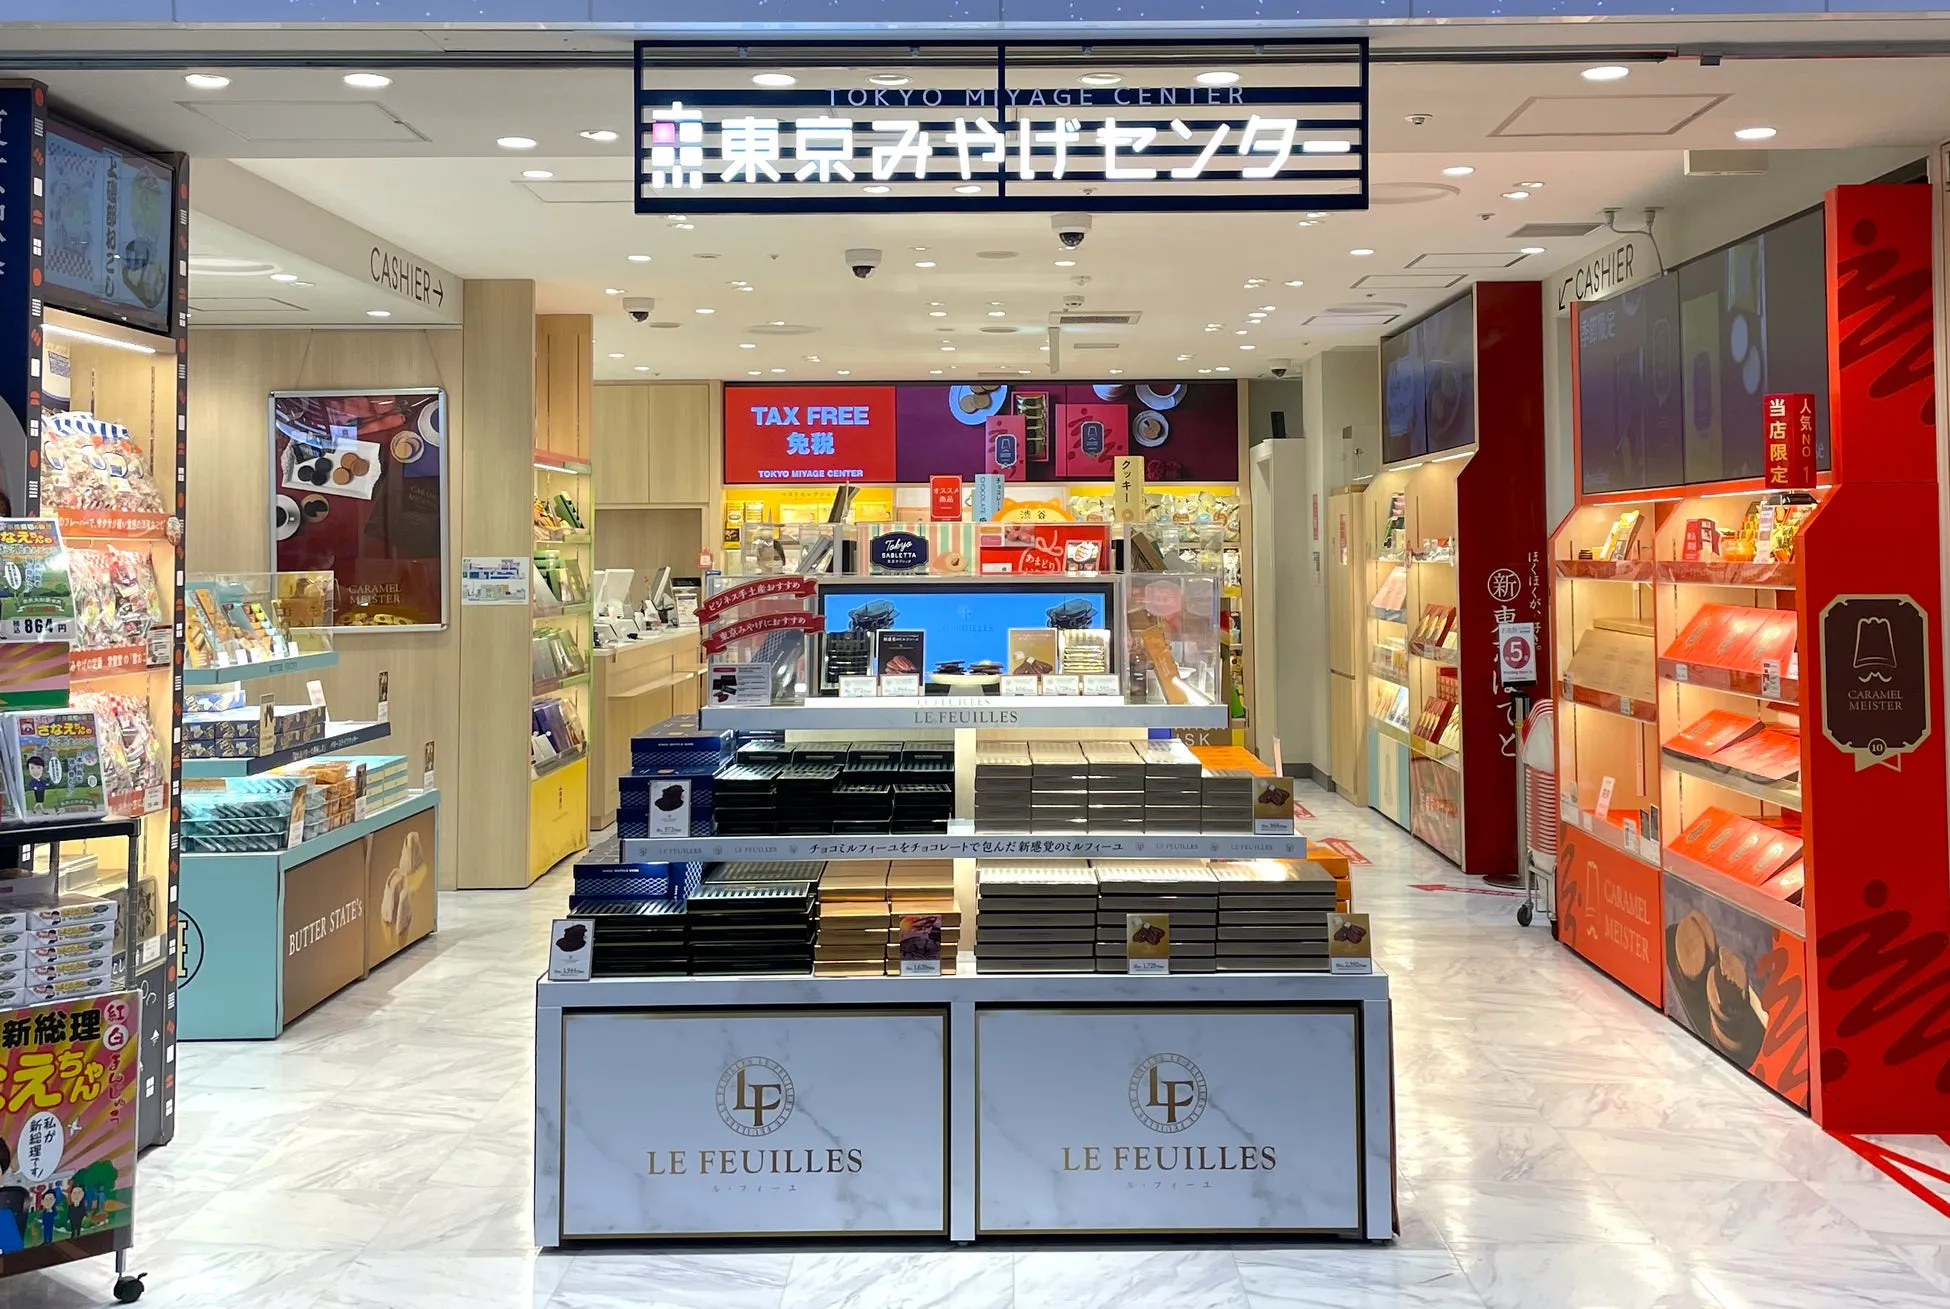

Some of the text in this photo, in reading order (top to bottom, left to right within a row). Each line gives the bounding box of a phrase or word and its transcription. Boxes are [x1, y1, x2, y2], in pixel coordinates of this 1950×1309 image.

[826, 85, 1245, 107] TOKYO MIYAGE CENTER
[720, 114, 1351, 181] 東京みやげセンター
[370, 246, 430, 305] CASHIER
[1575, 244, 1635, 300] CASHIER
[751, 406, 870, 426] TAX FREE
[786, 432, 836, 455] 免税
[1769, 398, 1789, 484] 当店限定
[758, 469, 864, 478] TOKYO MIYAGE CENTER
[1121, 460, 1132, 503] クッキー
[933, 487, 961, 495] オススメ
[1020, 510, 1046, 519] 渋谷
[885, 538, 913, 552] Tokyo
[348, 583, 402, 594] CARAMEL
[349, 593, 401, 605] MEISTER
[708, 580, 801, 612] ビジネス手土産おすすめ
[24, 618, 54, 634] 864
[57, 623, 67, 633] 円
[719, 616, 806, 641] 東京みやげにおすすめ
[1510, 641, 1523, 662] 5
[1847, 690, 1904, 700] CARAMEL
[1848, 701, 1904, 711] MEISTER
[914, 710, 1018, 724] LE FEUILLES
[1871, 743, 1884, 752] 10
[1604, 879, 1651, 925] CARAMEL
[289, 897, 364, 957] BUTTER STATE's
[1605, 914, 1650, 964] MEISTER
[2, 1008, 102, 1050] 新総理
[0, 1050, 104, 1113] えちゃん
[43, 1116, 57, 1145] 私が
[646, 1148, 863, 1175] LE FEUILLES
[1061, 1145, 1277, 1171] LE FEUILLES
